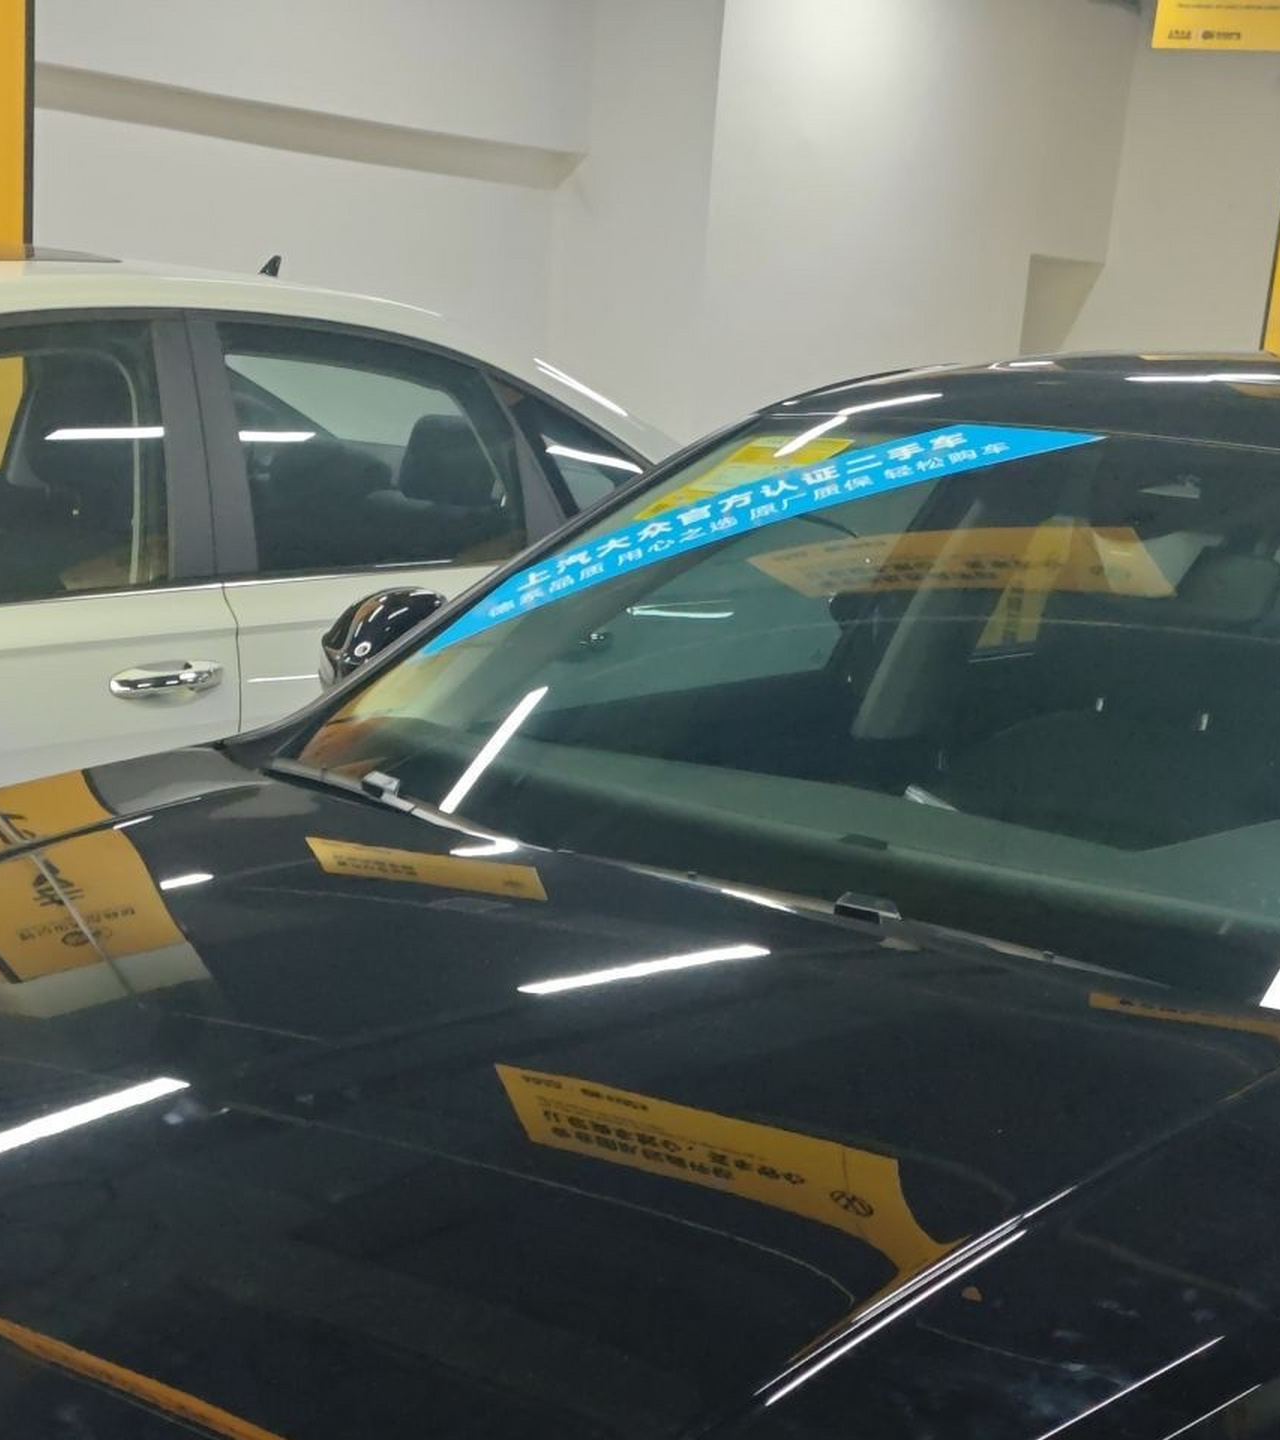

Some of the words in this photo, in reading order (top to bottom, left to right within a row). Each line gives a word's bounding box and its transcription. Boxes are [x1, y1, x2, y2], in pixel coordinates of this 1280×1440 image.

[517, 432, 967, 590] 上汽大众官方认证二手车
[750, 475, 874, 521] 原厂质保
